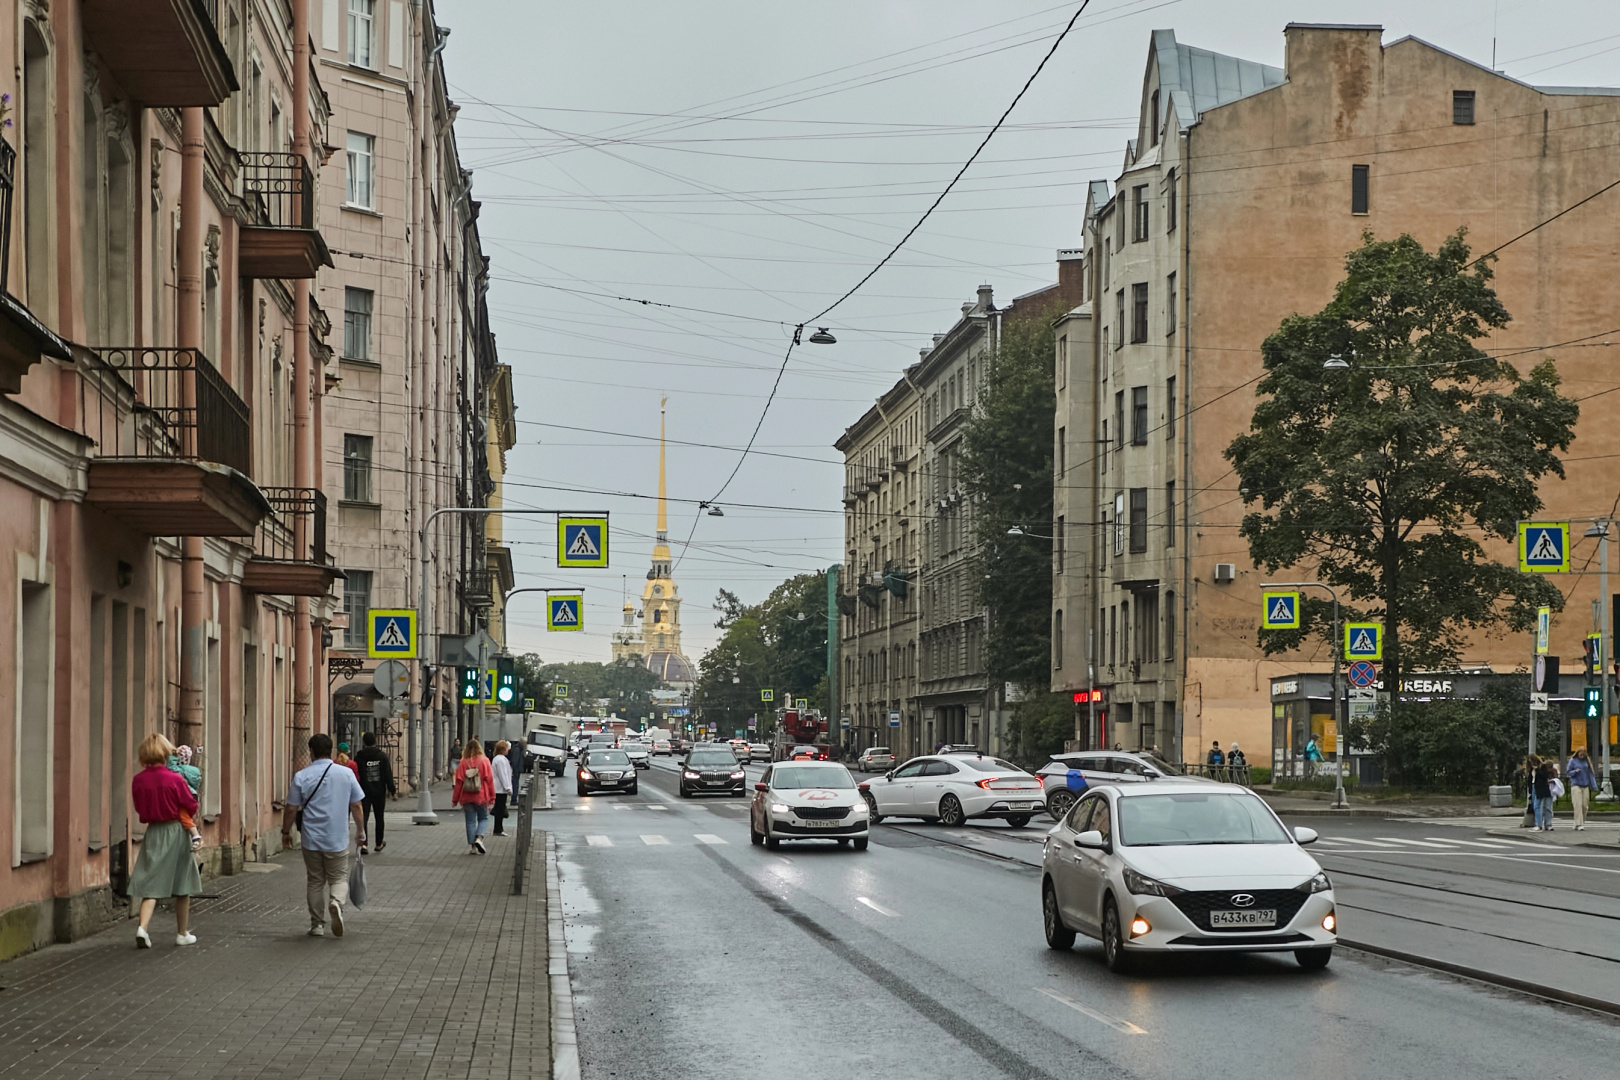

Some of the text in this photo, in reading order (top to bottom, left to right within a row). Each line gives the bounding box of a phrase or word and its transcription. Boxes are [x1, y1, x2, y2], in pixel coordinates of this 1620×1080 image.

[1404, 680, 1452, 693] КЕБАБ
[1213, 911, 1274, 923] В433КВ 797
